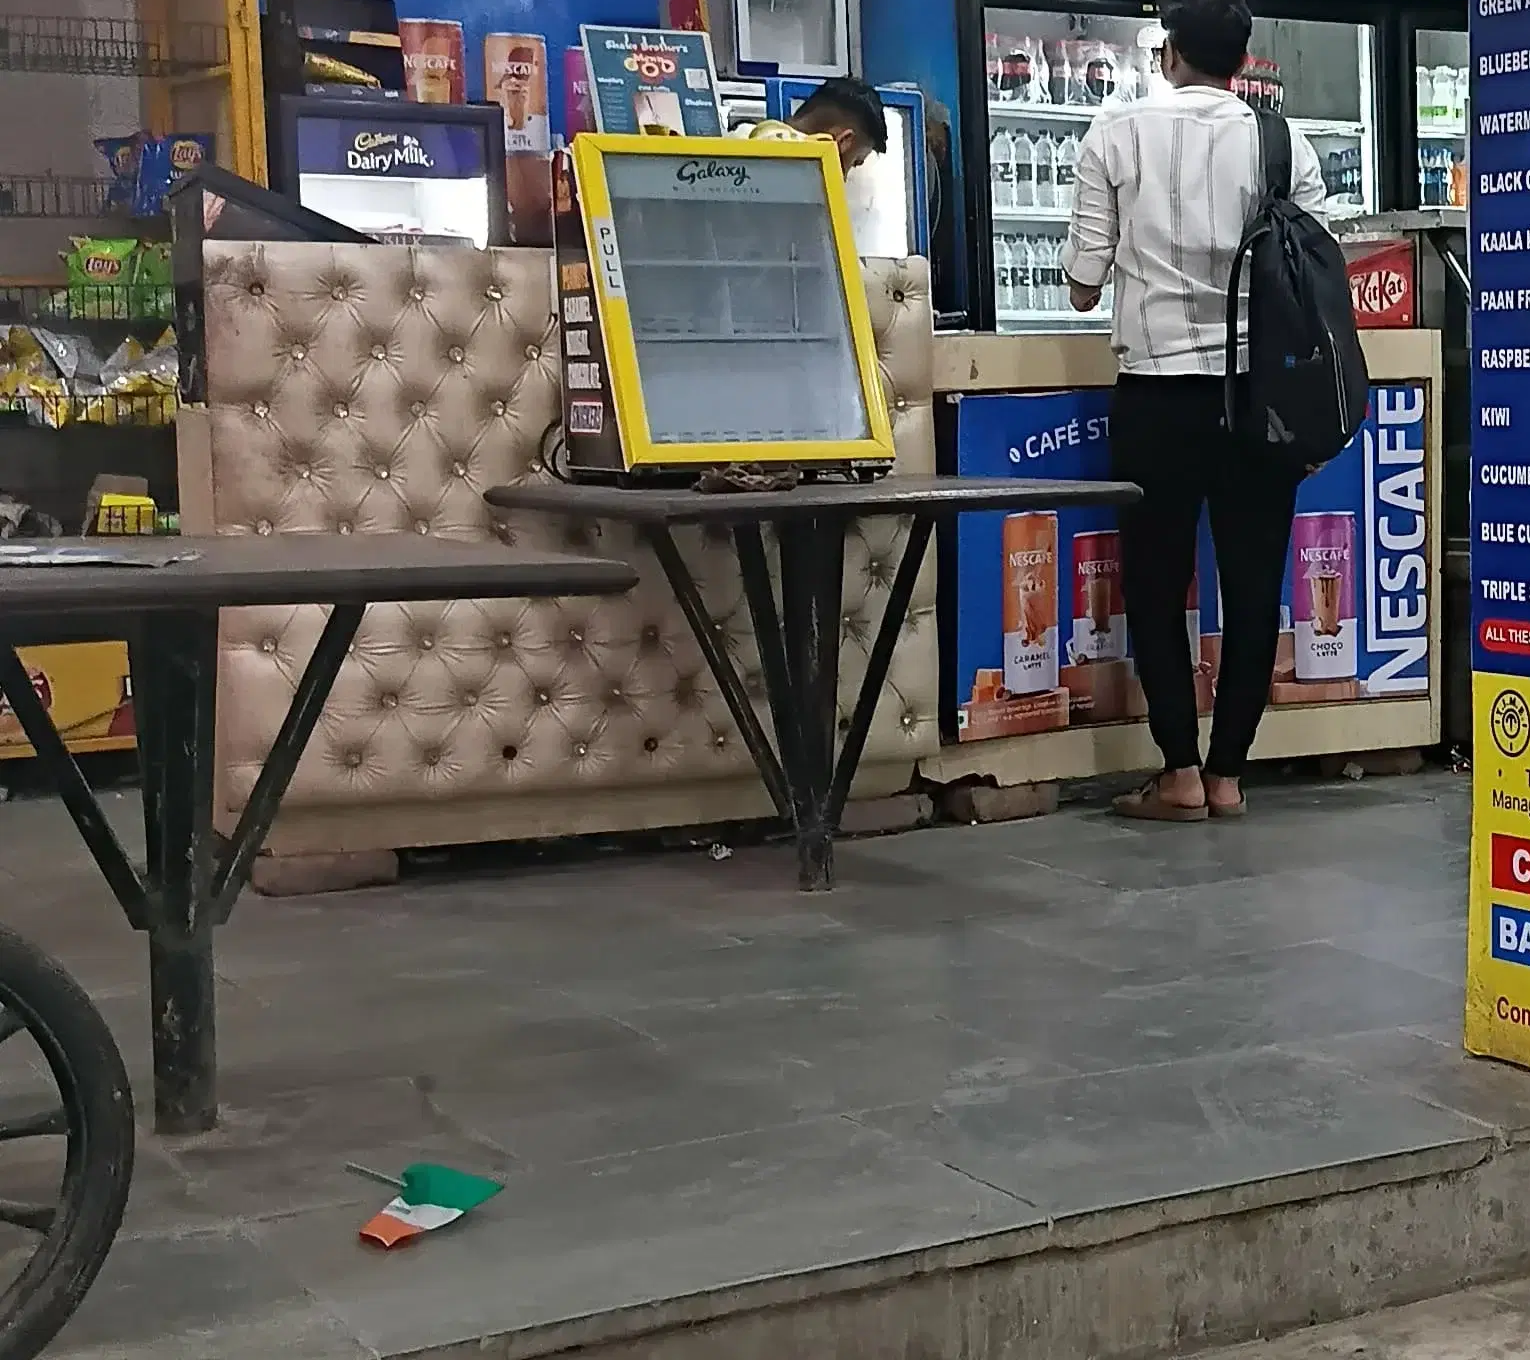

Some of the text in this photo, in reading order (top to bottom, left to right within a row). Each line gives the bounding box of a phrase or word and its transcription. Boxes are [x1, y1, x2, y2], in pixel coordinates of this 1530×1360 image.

[348, 151, 393, 172] Dairy
[677, 161, 751, 185] Galaxy
[1481, 171, 1522, 193] BLACK
[1481, 231, 1522, 252] KAALA
[600, 228, 620, 288] PULL
[1481, 290, 1514, 311] PAAN
[1481, 408, 1510, 426] KIWI
[1026, 419, 1080, 459] CAFÉ
[1481, 523, 1514, 542] BLUE
[1481, 580, 1525, 602] TRIPLE
[1311, 642, 1343, 651] CHOCO
